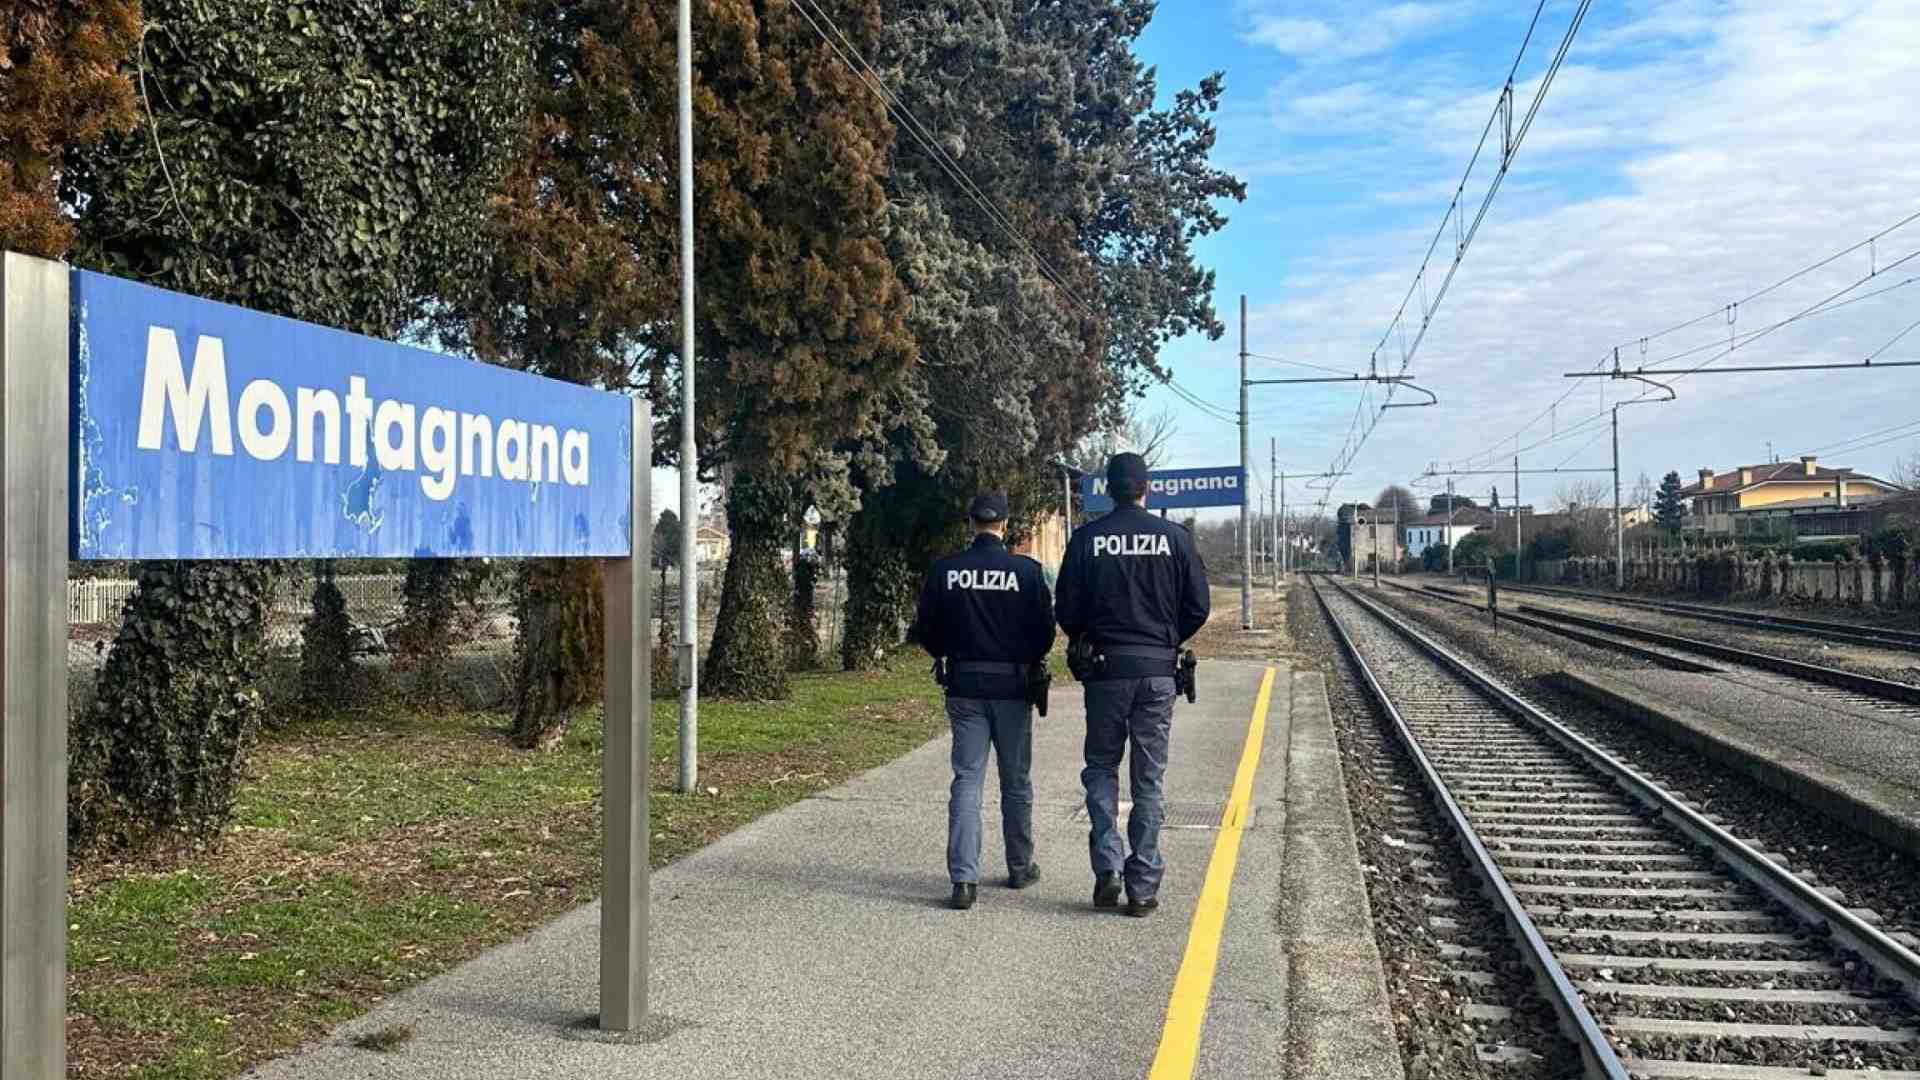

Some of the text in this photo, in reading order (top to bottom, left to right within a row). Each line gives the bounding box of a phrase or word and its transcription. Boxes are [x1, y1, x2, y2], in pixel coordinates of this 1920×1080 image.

[138, 326, 589, 500] Montagnana
[1092, 475, 1238, 495] Magnana
[1093, 533, 1172, 557] POLIZIA
[946, 569, 1020, 592] POLIZIA
